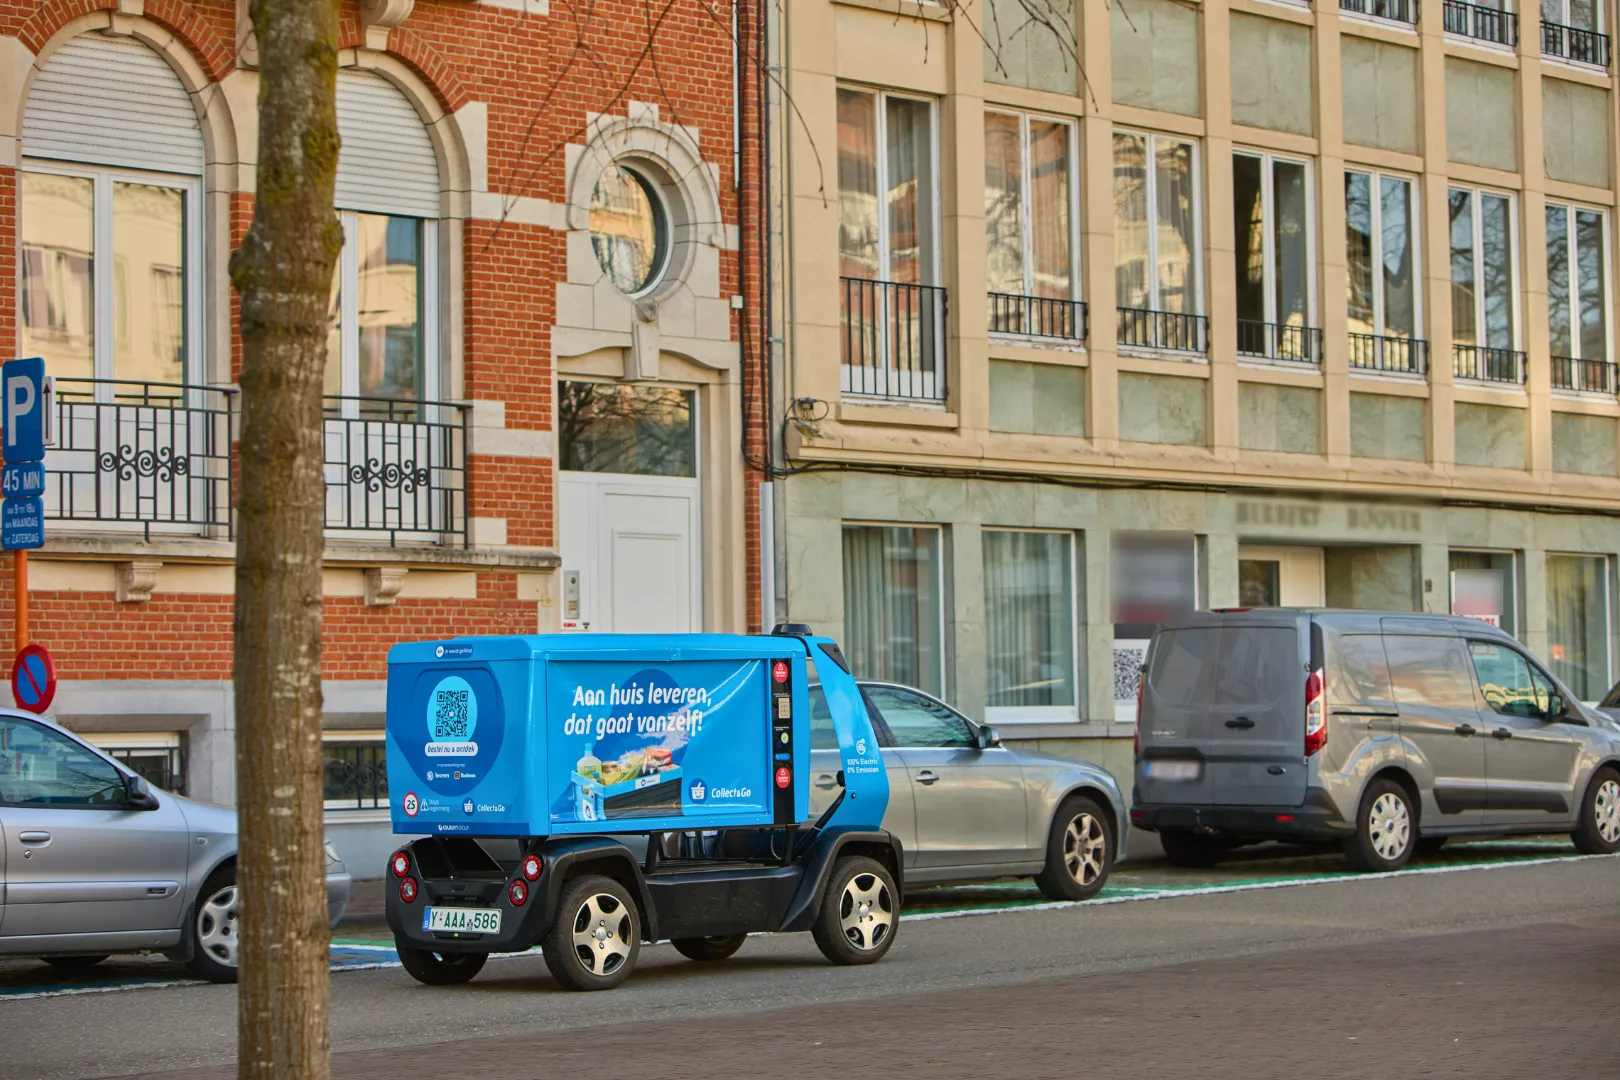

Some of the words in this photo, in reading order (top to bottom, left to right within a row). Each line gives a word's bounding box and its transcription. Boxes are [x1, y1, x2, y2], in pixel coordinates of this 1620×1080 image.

[8, 375, 36, 447] P
[3, 469, 20, 492] 45
[23, 470, 41, 491] MIN
[12, 516, 39, 528] MAANDAG
[12, 532, 40, 544] ZATERDAG
[572, 685, 605, 707] Aan
[609, 682, 644, 706] huis
[648, 682, 712, 707] leveren,
[564, 712, 593, 736] dat
[596, 712, 634, 741] gaat
[637, 709, 703, 737] vanzelf!
[427, 745, 444, 753] bestel
[455, 744, 475, 753] ontdek
[847, 758, 860, 766] 100%
[856, 766, 879, 774] Emission
[711, 787, 752, 799] Collect&Go
[406, 799, 416, 810] 25
[477, 804, 506, 812] Collect&Go
